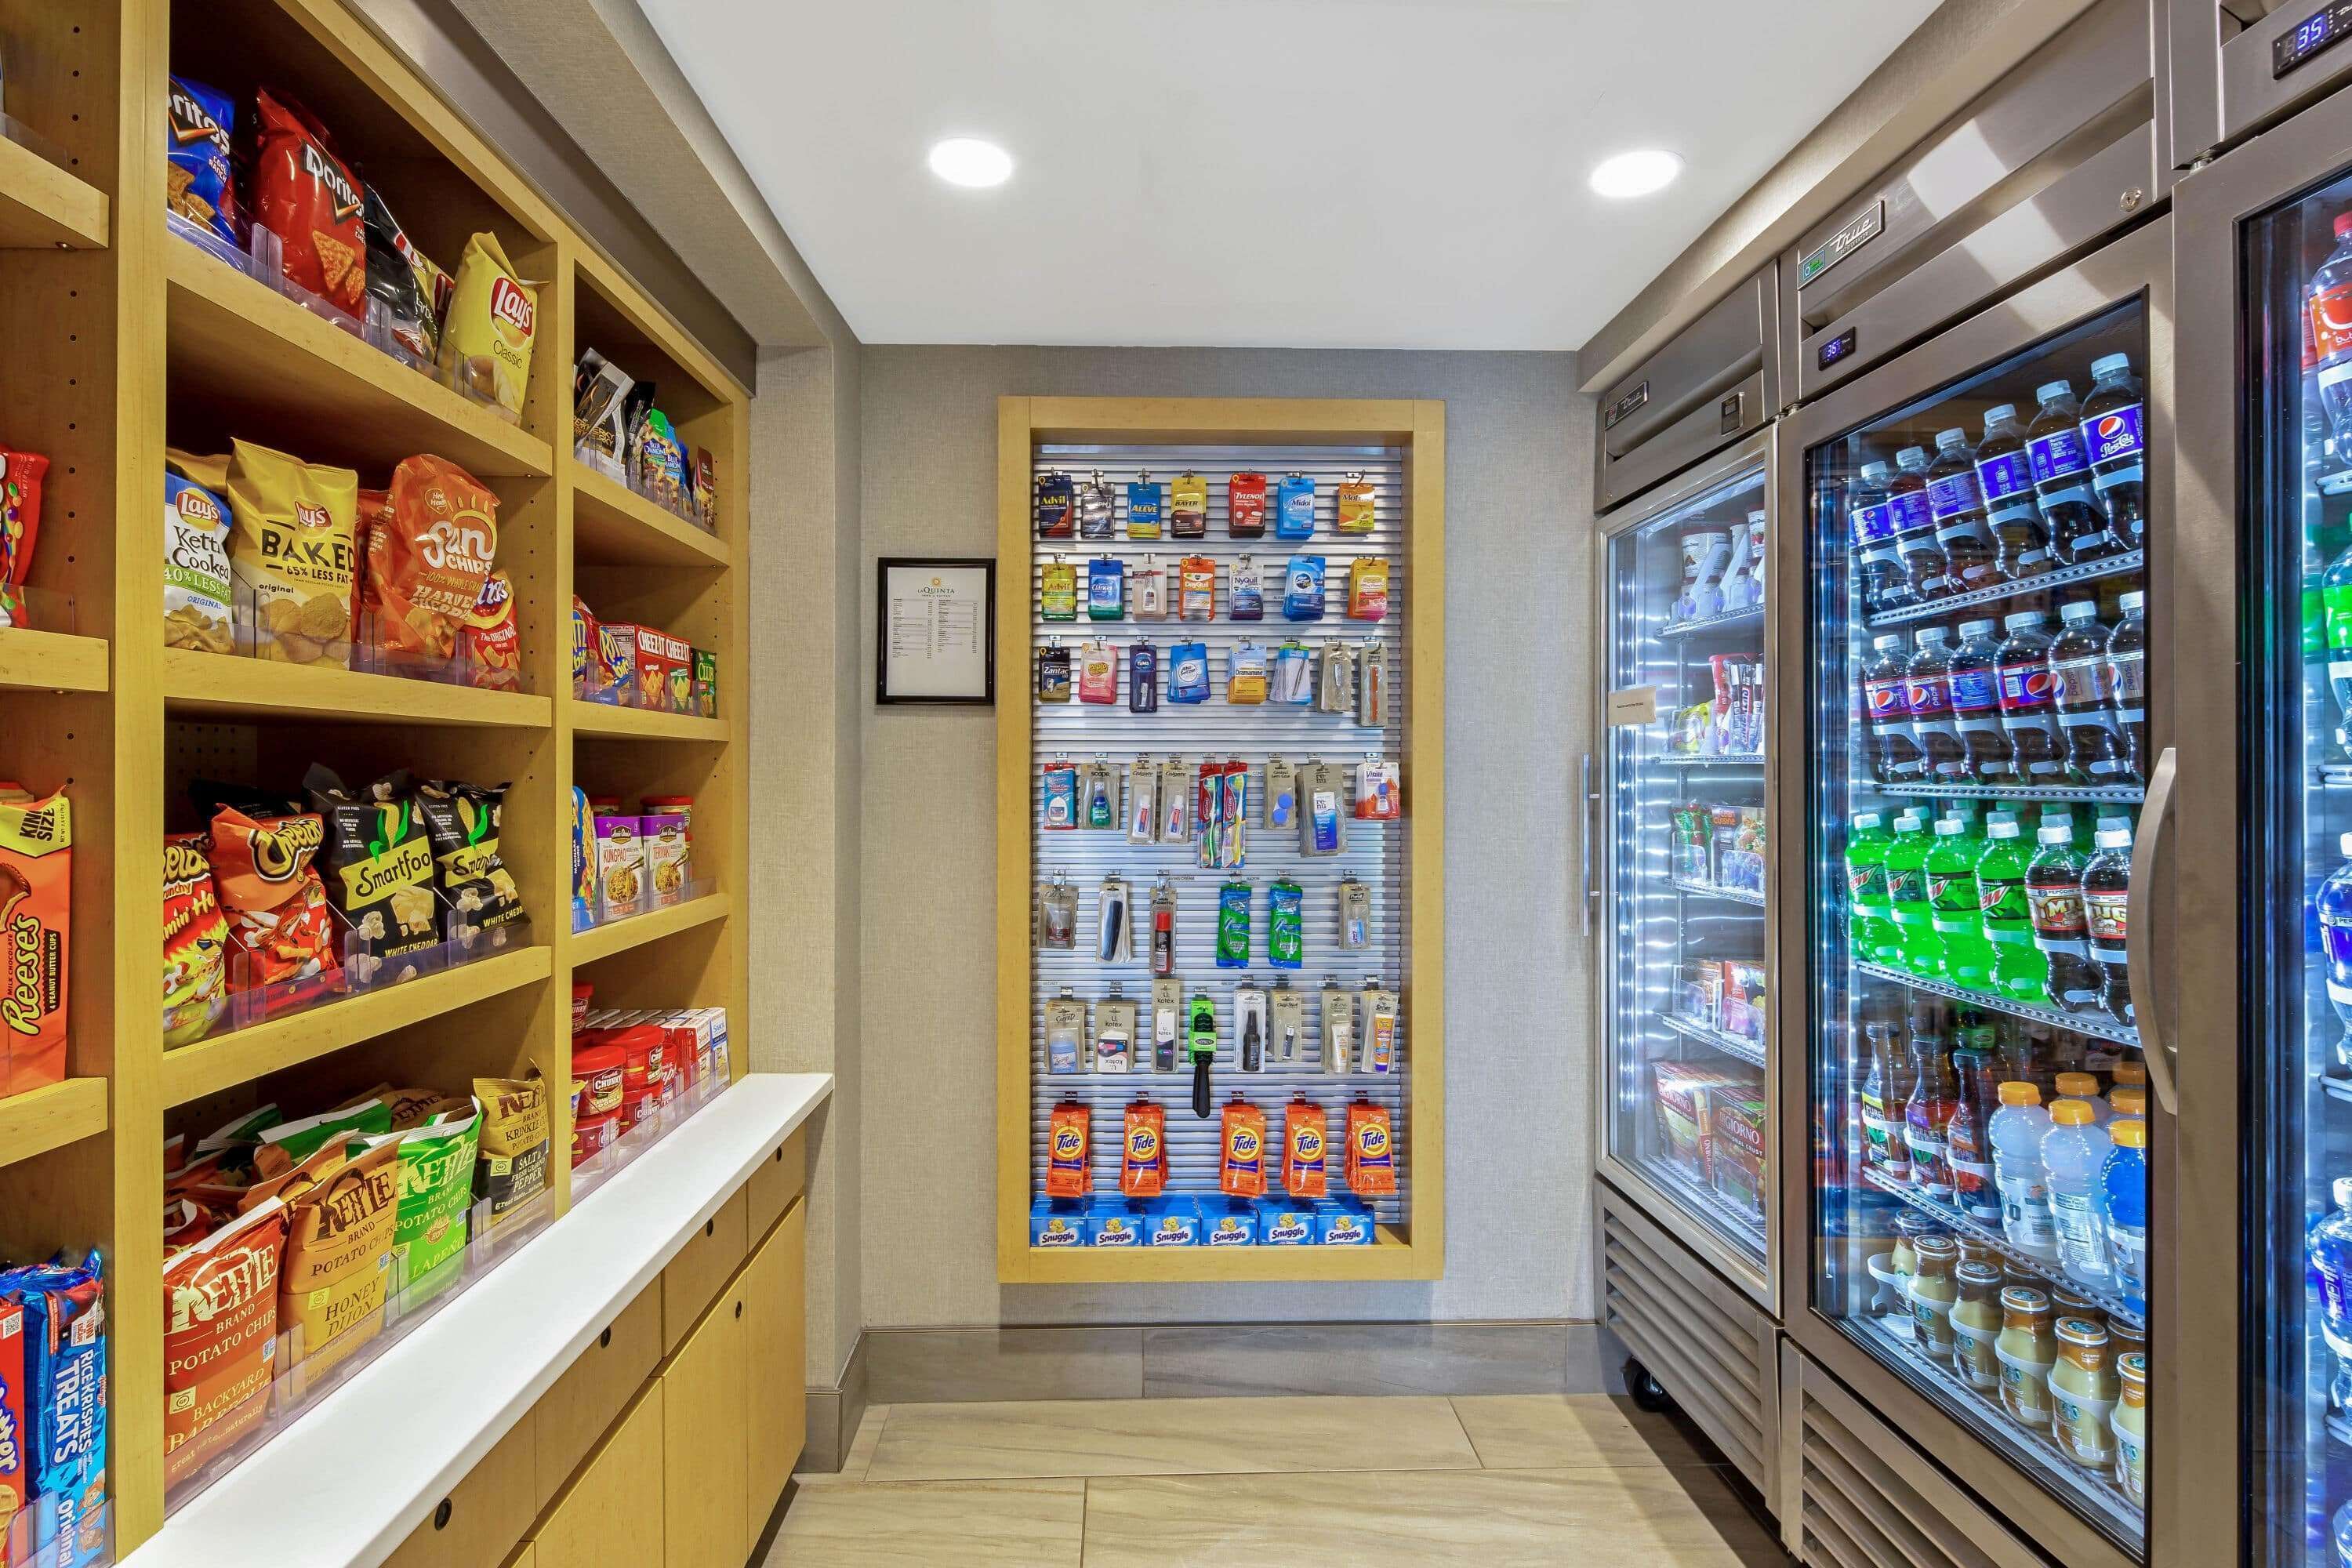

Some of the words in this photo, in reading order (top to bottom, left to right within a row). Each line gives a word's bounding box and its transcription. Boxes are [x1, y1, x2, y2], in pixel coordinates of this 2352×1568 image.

[2297, 16, 2323, 49] 35
[208, 159, 227, 183] RANCH
[494, 281, 532, 328] Lay's
[493, 339, 522, 369] Classic
[181, 493, 220, 521] Lay's
[1041, 495, 1066, 505] Advil
[1131, 504, 1158, 513] ALEVE
[1291, 498, 1312, 507] Midol
[194, 573, 221, 595] LESS
[311, 568, 334, 583] LESS
[336, 573, 350, 585] FAT
[1234, 576, 1258, 585] NyQuil
[259, 583, 294, 593] original
[187, 595, 223, 610] ORIGINAL
[491, 624, 517, 641] ORIGINAL
[1044, 666, 1069, 675] Zantac
[356, 849, 432, 898] Smartfoo
[482, 915, 505, 928] WHITE
[505, 906, 524, 921] CHEDD
[384, 944, 407, 958] WHITE
[2, 913, 41, 1036] Reese's
[594, 1074, 622, 1091] CHUNKY
[1056, 1134, 1080, 1151] Tide
[1131, 1134, 1156, 1152] Tide
[1232, 1135, 1257, 1152] Tide
[1297, 1135, 1320, 1152] Tide
[1361, 1131, 1385, 1149] Tide
[518, 1153, 537, 1171] SALT
[512, 1167, 543, 1193] PEPPER
[427, 1181, 454, 1205] BRAND
[309, 1167, 397, 1243] KETTLE
[395, 1203, 446, 1232] POTATO
[447, 1185, 468, 1209] CHIPS
[347, 1221, 376, 1245] BRAND
[1042, 1232, 1075, 1243] Snuggle
[1099, 1232, 1132, 1243] Snuggle
[1156, 1231, 1189, 1242] Snuggle
[1213, 1230, 1247, 1242] Snuggle
[1271, 1227, 1305, 1240] Snuggle
[1328, 1229, 1361, 1242] Snuggle
[311, 1244, 367, 1277] POTATO
[164, 1243, 278, 1336] KETTLE
[325, 1276, 381, 1322] HONEY
[216, 1303, 256, 1335] BRAND
[326, 1298, 375, 1339] DIJON
[169, 1332, 242, 1376] POTATO
[245, 1305, 277, 1339] CHIPS
[80, 1348, 95, 1385] RICE
[192, 1367, 264, 1423] BACKYARD
[54, 1358, 80, 1465] TREATS
[78, 1383, 96, 1453] KRISPIES
